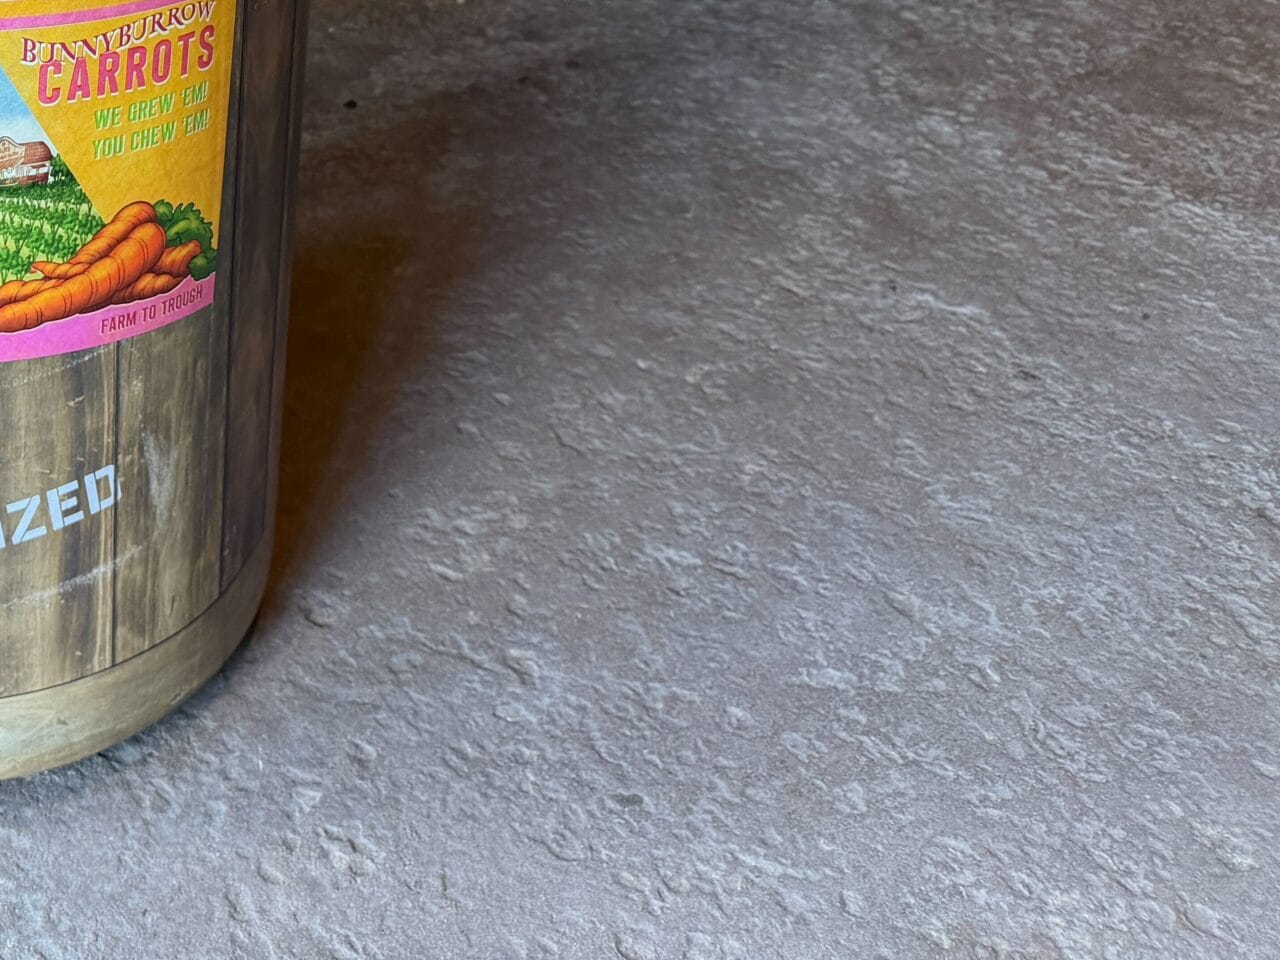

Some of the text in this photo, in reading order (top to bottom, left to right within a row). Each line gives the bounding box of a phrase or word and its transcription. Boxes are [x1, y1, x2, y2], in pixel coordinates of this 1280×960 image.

[21, 0, 216, 65] BUNNYBURROW
[38, 24, 216, 107] CARROTS
[94, 106, 123, 131] WE
[128, 92, 175, 124] GREW
[93, 136, 125, 161] YOU
[131, 120, 177, 153] CHEW
[101, 284, 203, 335] FARM TO TROUGH
